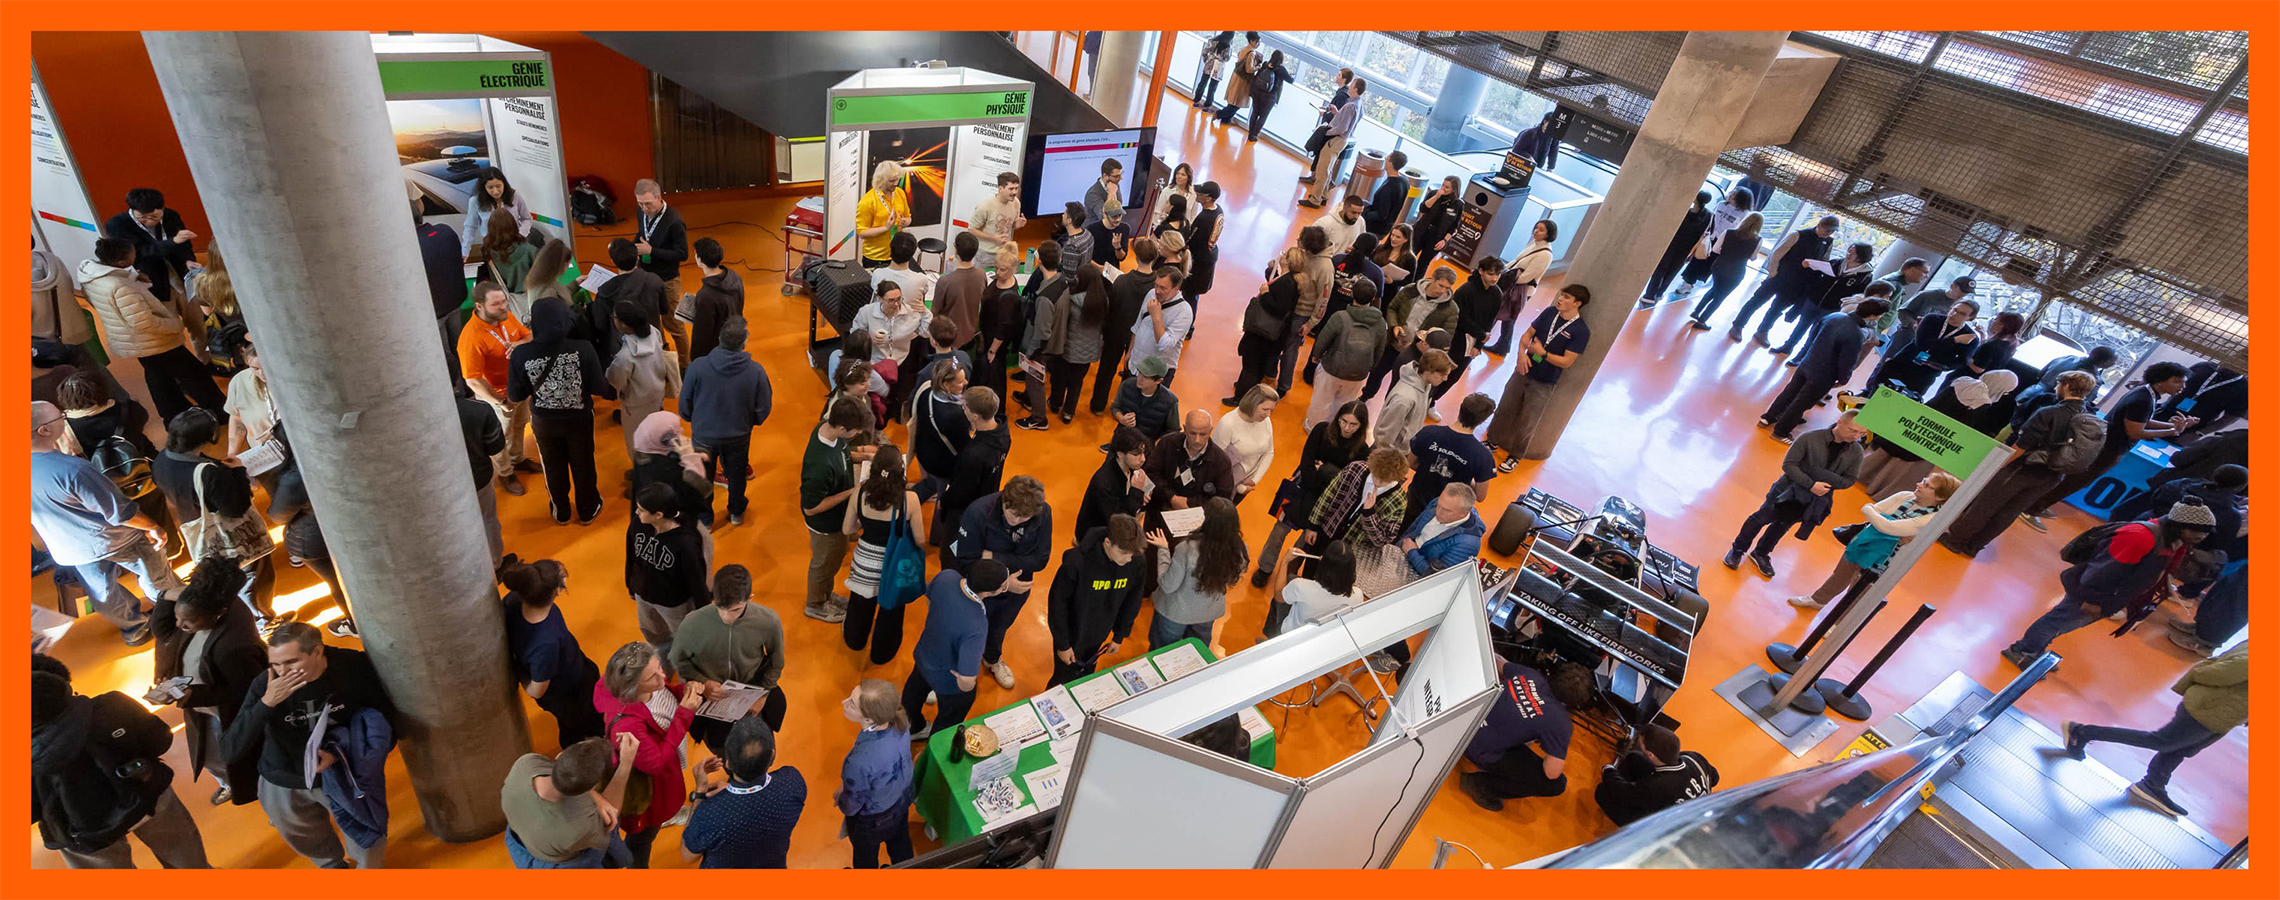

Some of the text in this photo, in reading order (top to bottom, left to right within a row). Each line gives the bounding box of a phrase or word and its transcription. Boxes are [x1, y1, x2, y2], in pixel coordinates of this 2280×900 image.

[512, 61, 542, 75] GÉNIE
[480, 74, 545, 88] ÉLECTRIQUE
[986, 103, 1025, 115] PHYSIQUE
[1004, 92, 1026, 104] GÉNIE
[1898, 416, 1964, 454] POLYTECHNIQUE
[1917, 416, 1957, 439] FORMULE
[1902, 429, 1946, 456] MONTRÉAL
[634, 532, 676, 571] GAP
[1519, 591, 1666, 675] TAKING OFF LIKE FIREWORKS
